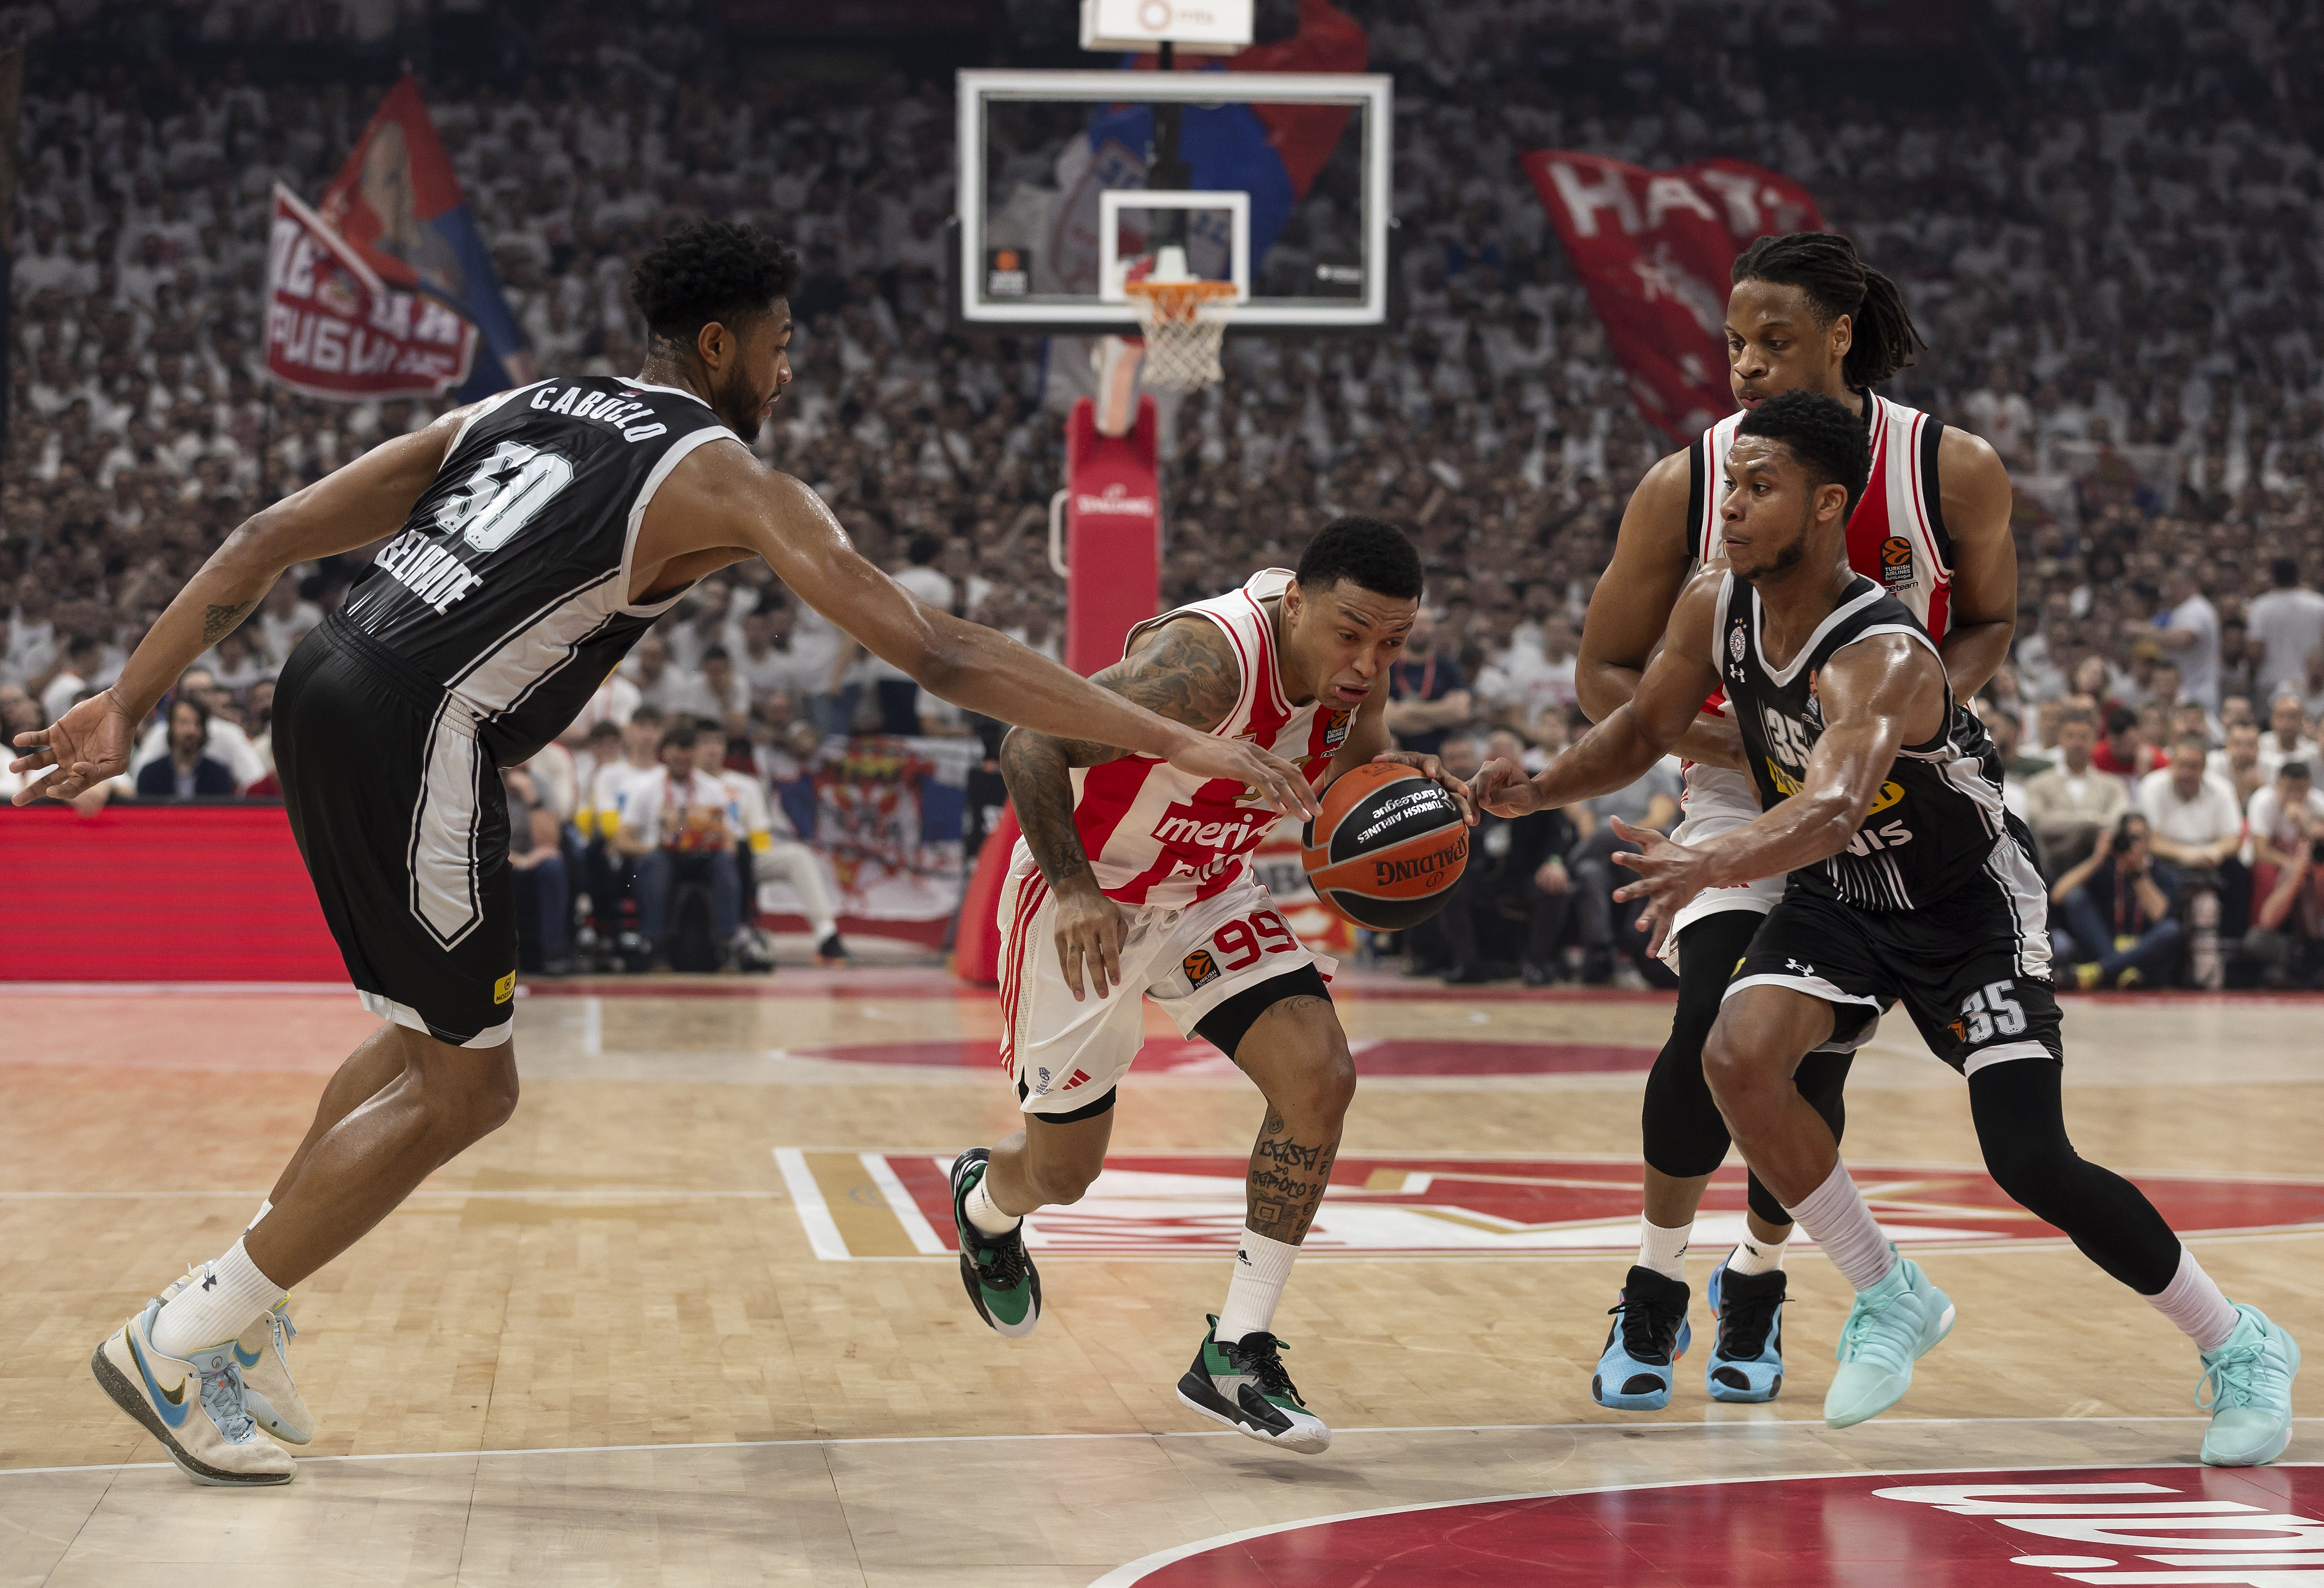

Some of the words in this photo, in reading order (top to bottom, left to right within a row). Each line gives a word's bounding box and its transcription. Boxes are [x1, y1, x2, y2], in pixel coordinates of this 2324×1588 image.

[1327, 731, 1344, 739] AIRLINES
[1766, 707, 1812, 770] 35
[1372, 789, 1438, 820] EuroLeague
[1403, 799, 1444, 818] TURKISH
[1357, 811, 1402, 844] AIRLINES
[1375, 831, 1467, 886] SPALDING
[1213, 910, 1299, 971] 99
[1195, 969, 1217, 988] TURKISH
[1960, 979, 2028, 1044] 35
[1259, 1137, 1323, 1171] CASA
